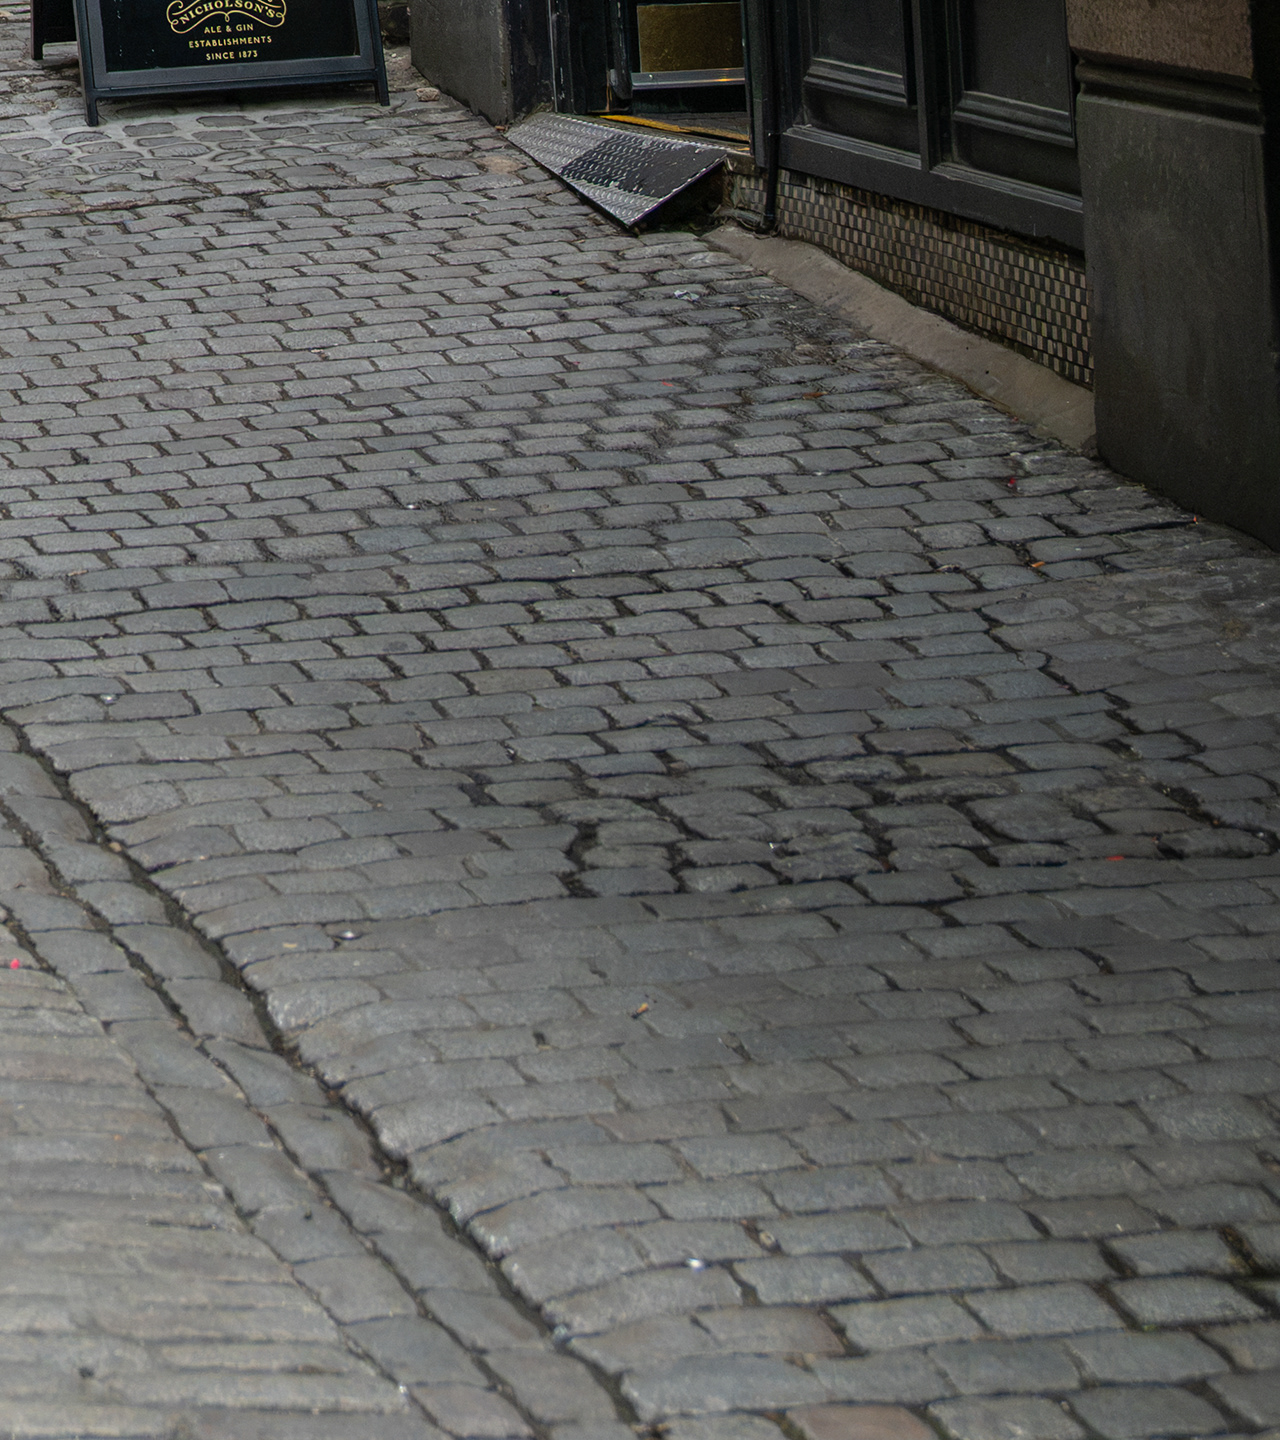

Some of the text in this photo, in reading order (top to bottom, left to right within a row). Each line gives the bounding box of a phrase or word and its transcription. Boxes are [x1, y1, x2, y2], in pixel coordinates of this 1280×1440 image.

[179, 0, 276, 24] NICHOLSON'S
[204, 23, 254, 34] ALE & GIN
[189, 36, 272, 48] ESTABLISHMENTS
[206, 50, 258, 60] SINCE 1873
